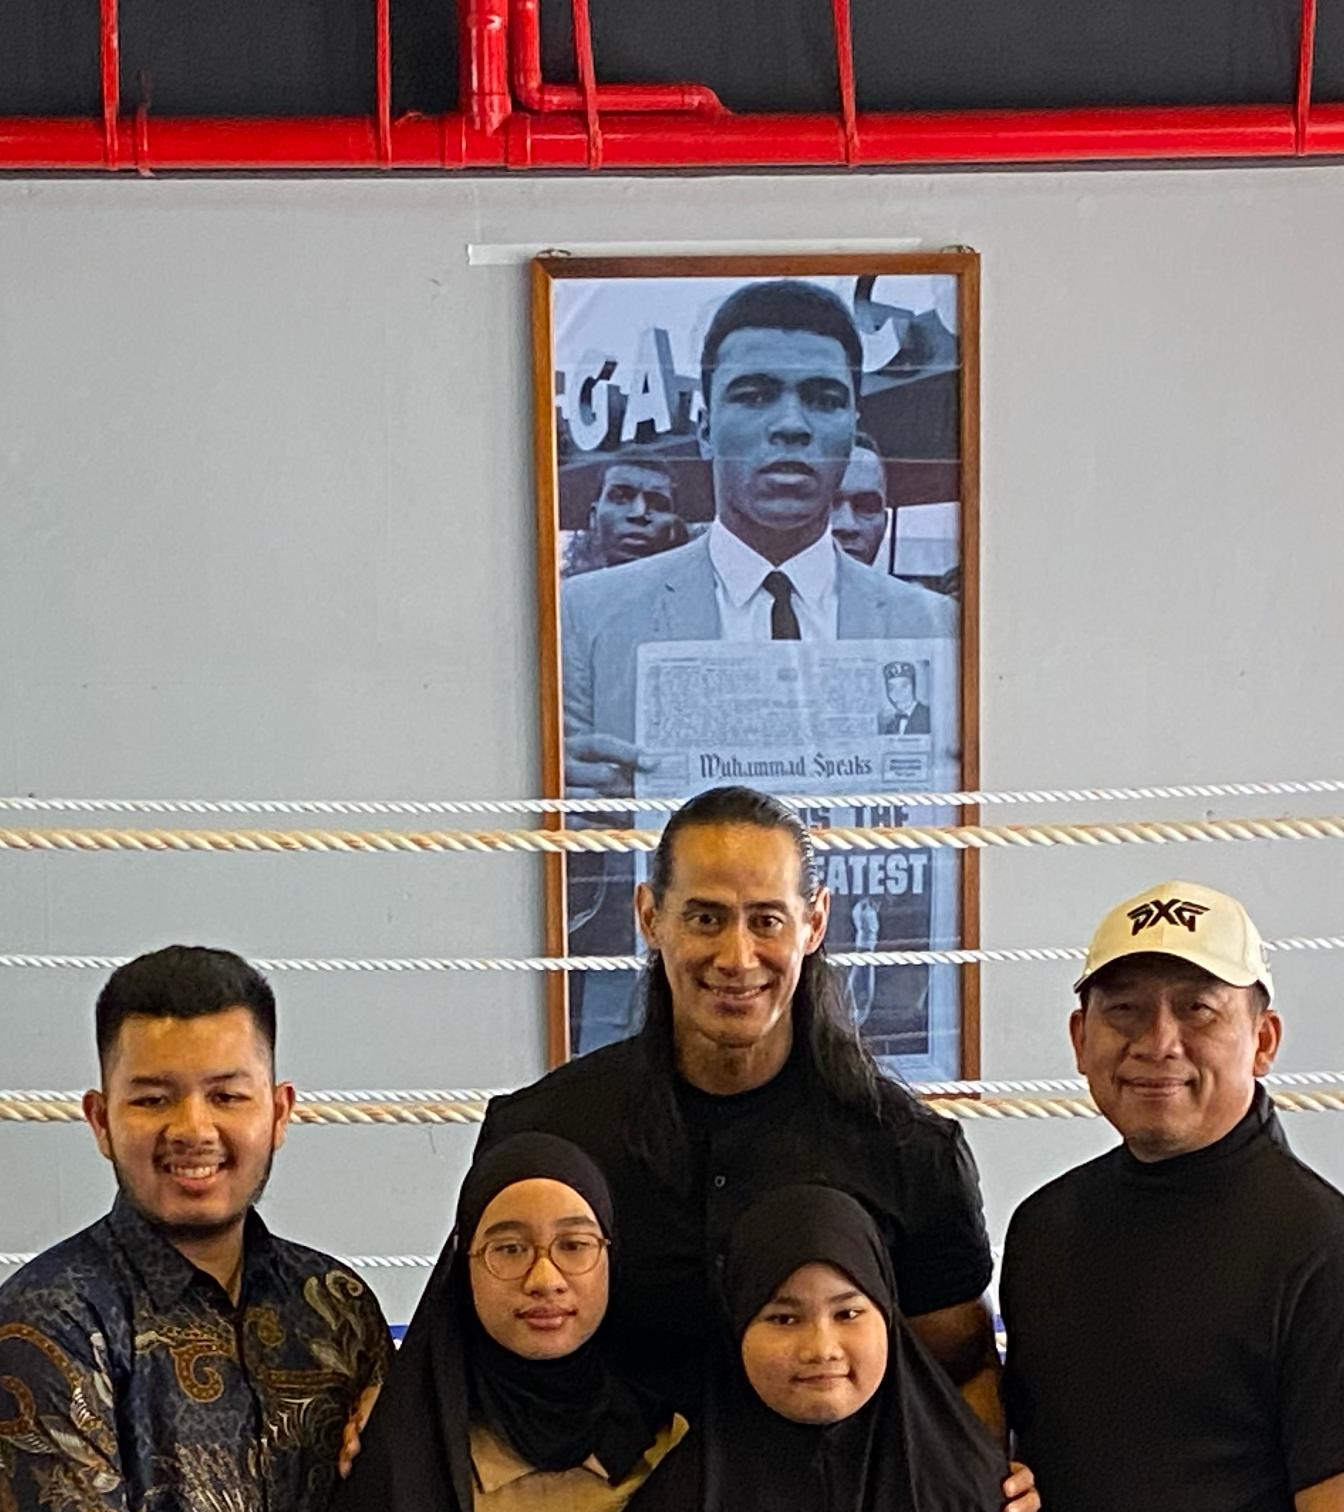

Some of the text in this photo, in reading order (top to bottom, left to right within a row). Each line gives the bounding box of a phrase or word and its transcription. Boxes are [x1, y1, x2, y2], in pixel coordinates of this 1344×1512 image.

[700, 752, 805, 780] Muhammad
[813, 752, 873, 779] Speaks
[812, 853, 928, 895] EATEST
[1127, 898, 1211, 936] PXG
